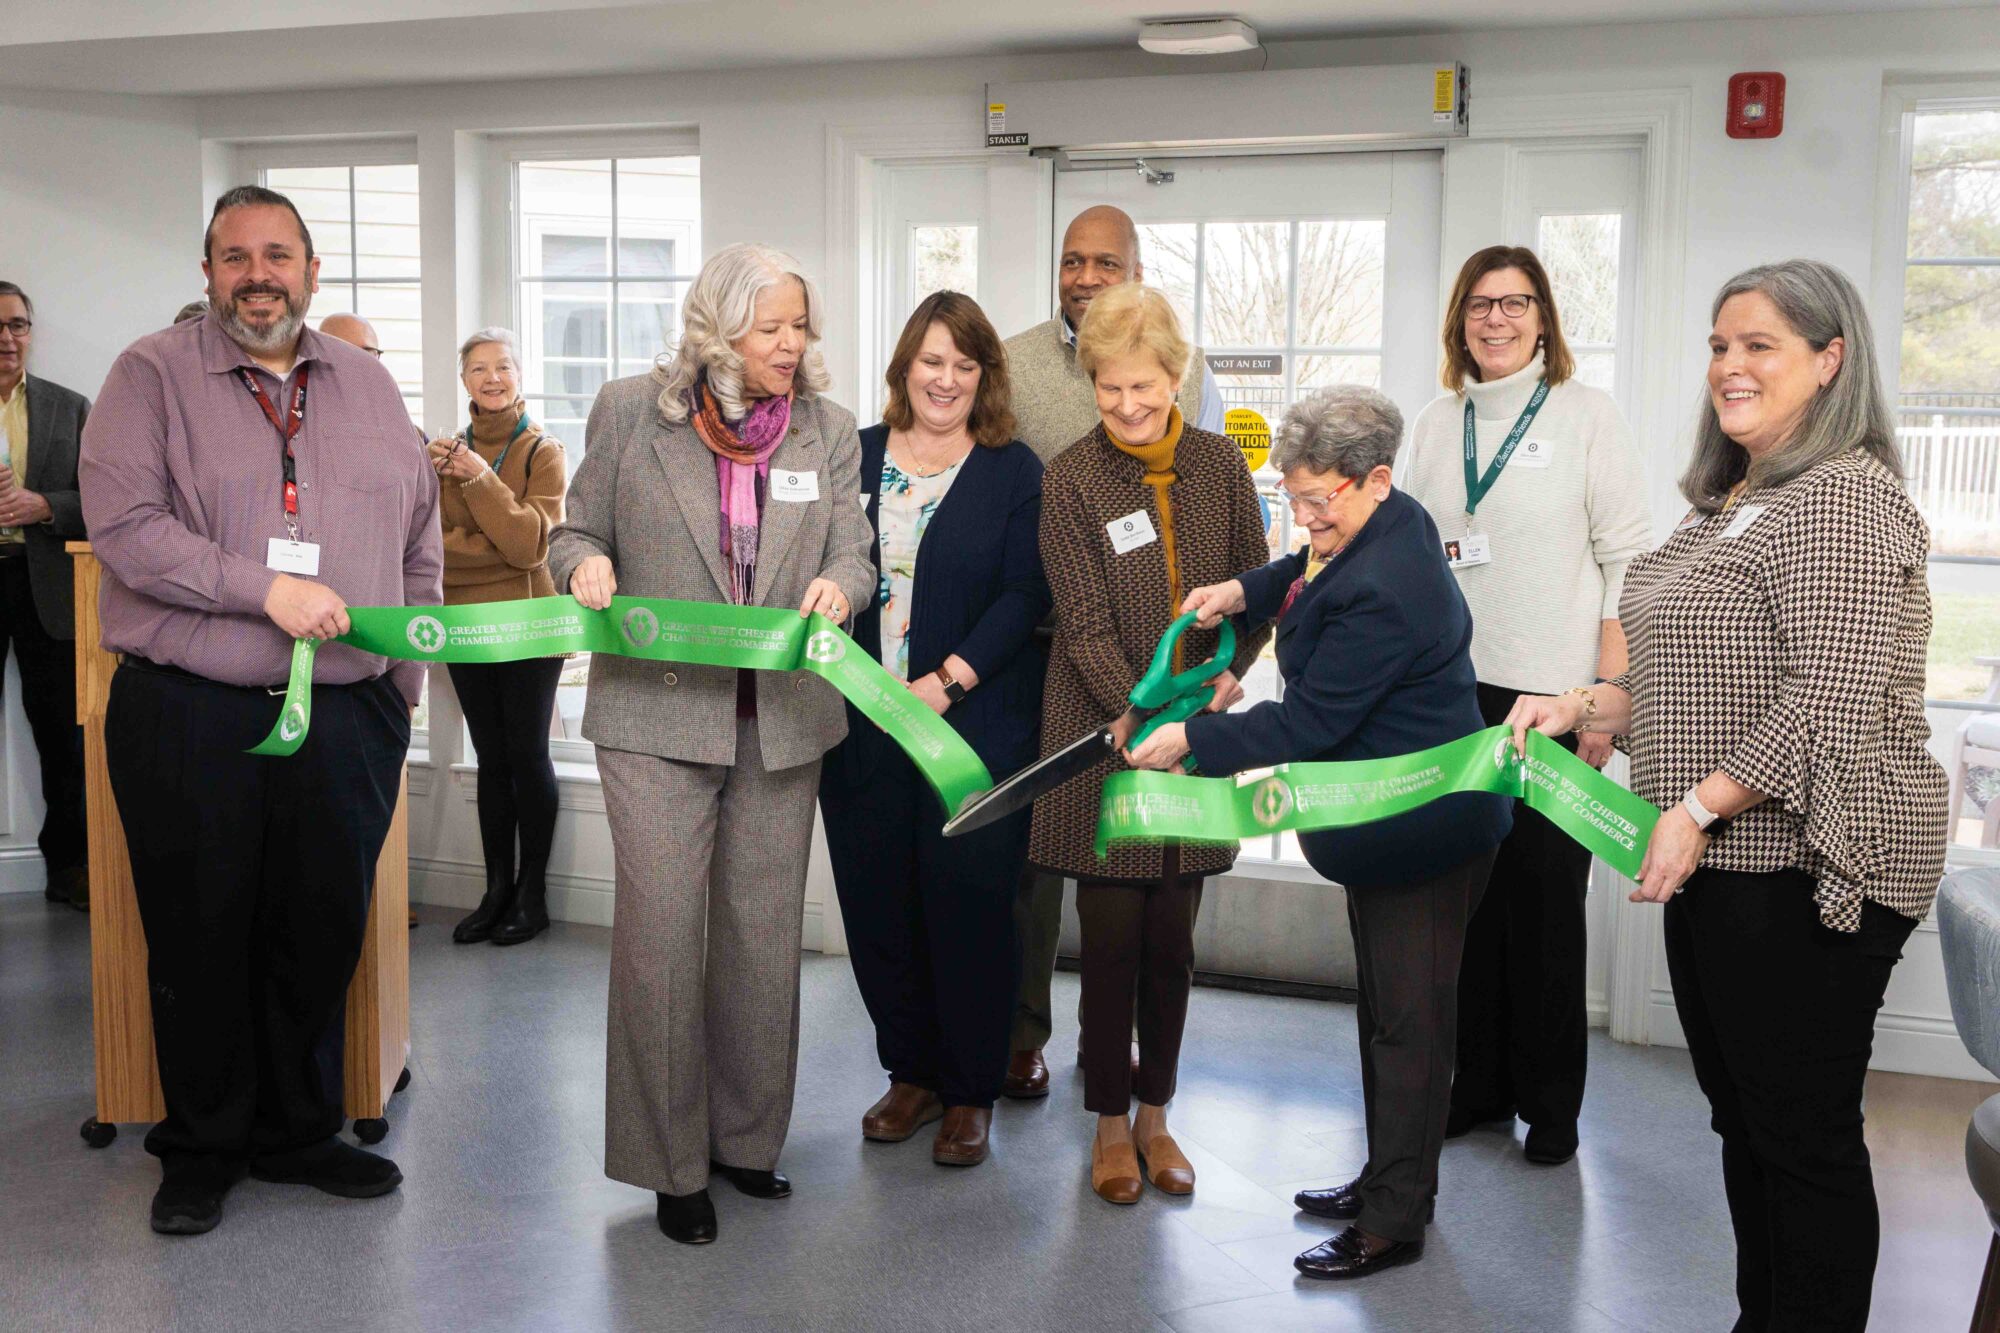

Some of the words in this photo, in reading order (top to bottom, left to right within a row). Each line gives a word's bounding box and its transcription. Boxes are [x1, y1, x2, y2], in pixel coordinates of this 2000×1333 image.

[989, 136, 1027, 144] STANLEY
[1213, 360, 1235, 368] NOT
[1236, 360, 1250, 368] AN
[1252, 360, 1272, 368] EXIT
[1225, 422, 1268, 431] TOMATIC
[1495, 440, 1518, 468] Barclay
[449, 625, 497, 636] GREATER
[499, 622, 528, 633] WEST
[531, 615, 580, 628] CHESTER
[450, 635, 503, 646] CHAMBER
[506, 633, 520, 643] OF
[523, 624, 585, 642] COMMERCE
[738, 628, 785, 641] CHESTER
[730, 638, 789, 651] COMMERCE
[1525, 754, 1560, 781] EATER
[1560, 776, 1591, 802] WEST
[1589, 800, 1639, 838] CHESTER
[1556, 789, 1573, 804] OF
[1571, 802, 1637, 851] COMMERCE
